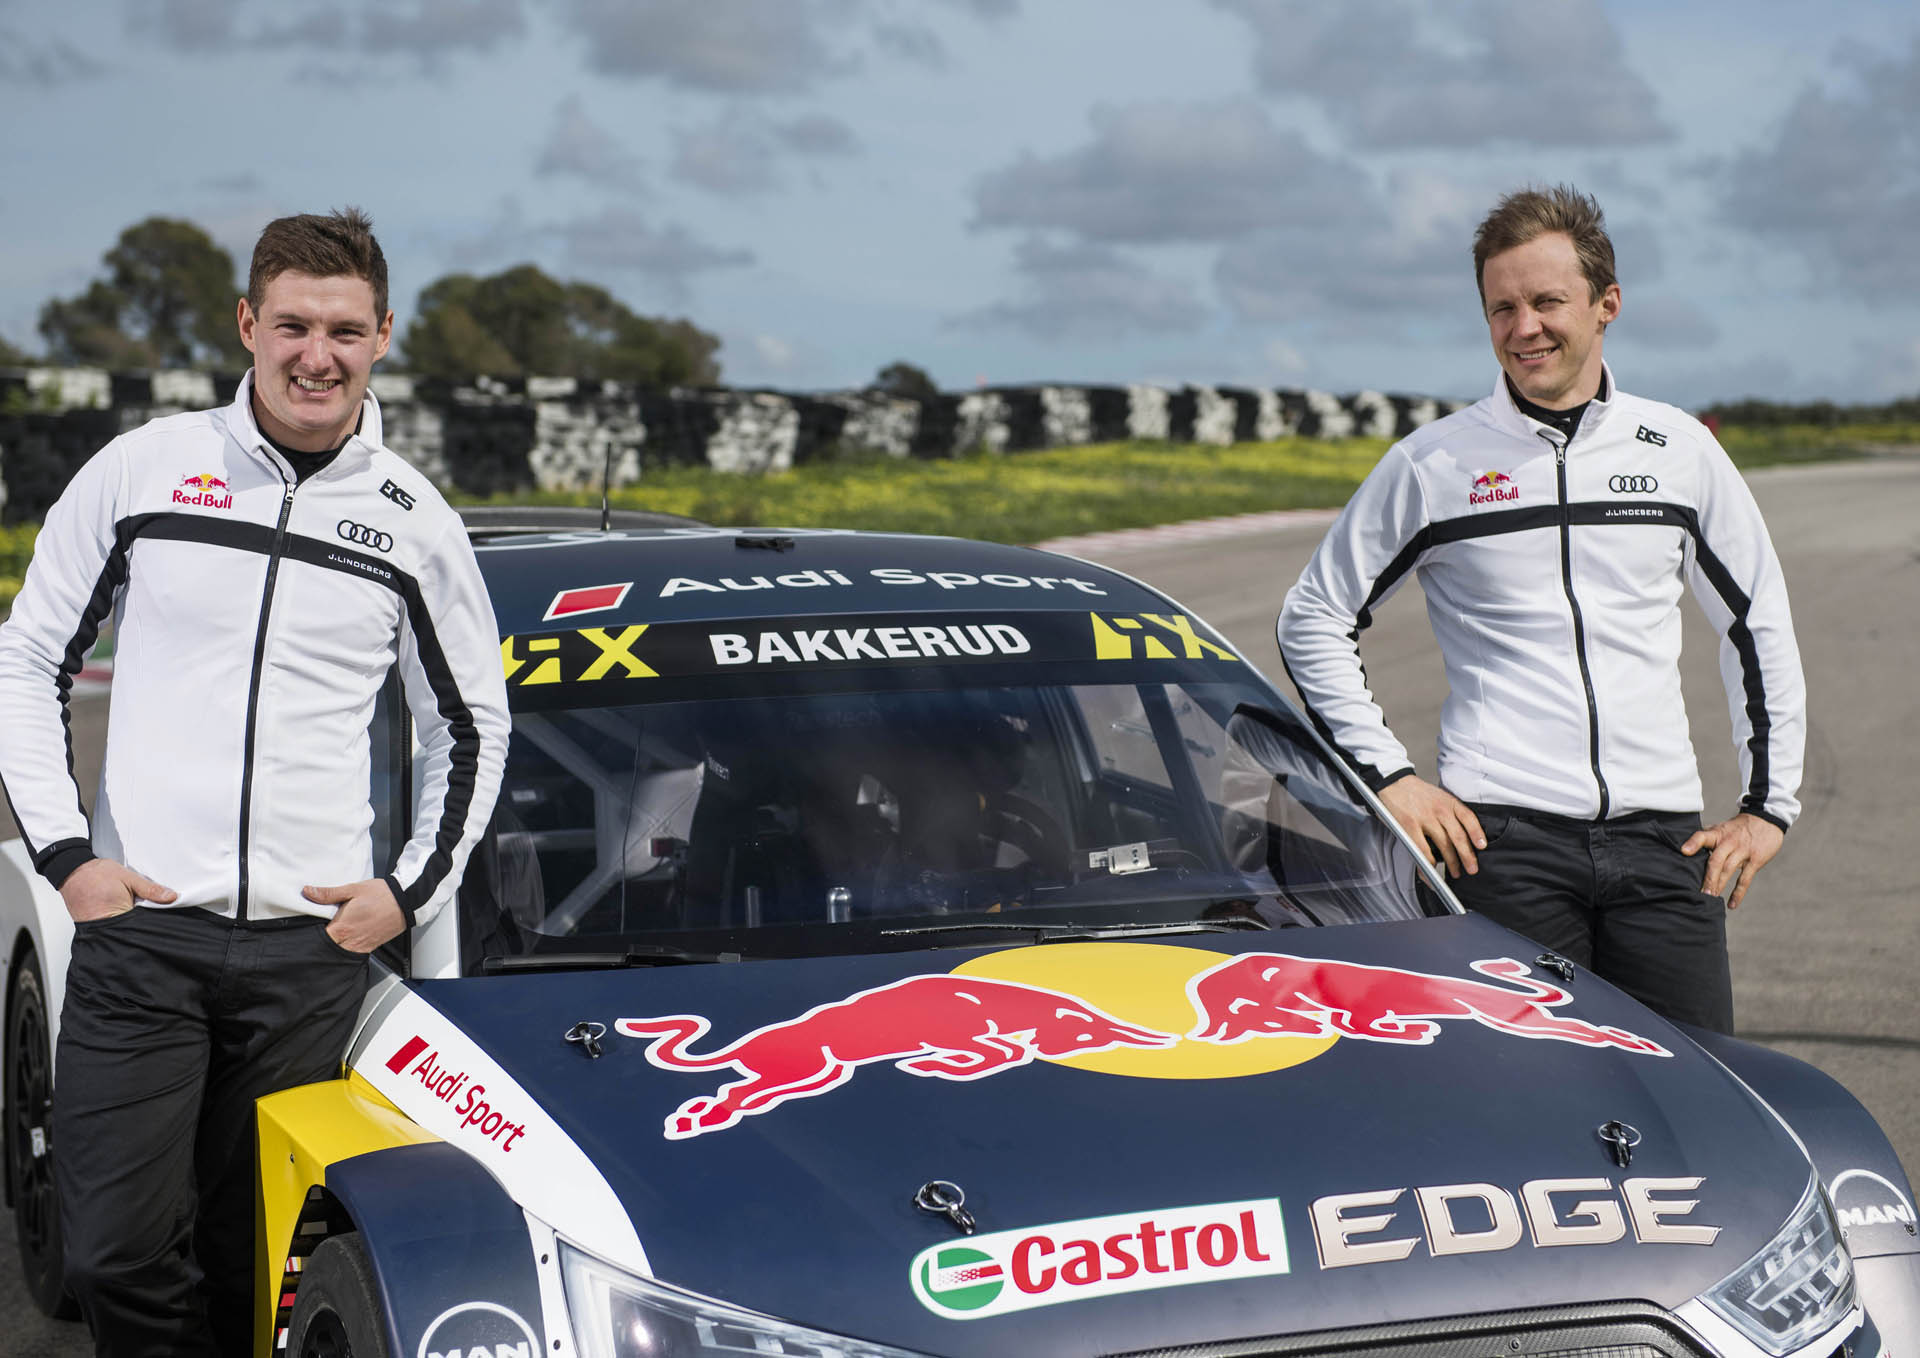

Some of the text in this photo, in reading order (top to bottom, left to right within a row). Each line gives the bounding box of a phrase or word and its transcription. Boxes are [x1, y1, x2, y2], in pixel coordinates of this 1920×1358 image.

[172, 490, 233, 510] Red Bull
[378, 478, 416, 512] EKS
[1469, 486, 1520, 504] Red Bull
[1605, 508, 1664, 517] J.LINDEBERG
[328, 553, 392, 580] J.LINDEBERG
[659, 568, 1108, 598] Audi Sport
[709, 624, 1031, 666] BAKKERUD
[410, 1051, 526, 1153] Audi Sport
[1837, 1204, 1911, 1227] MAN
[1011, 1176, 1722, 1294] Castrol EDGE
